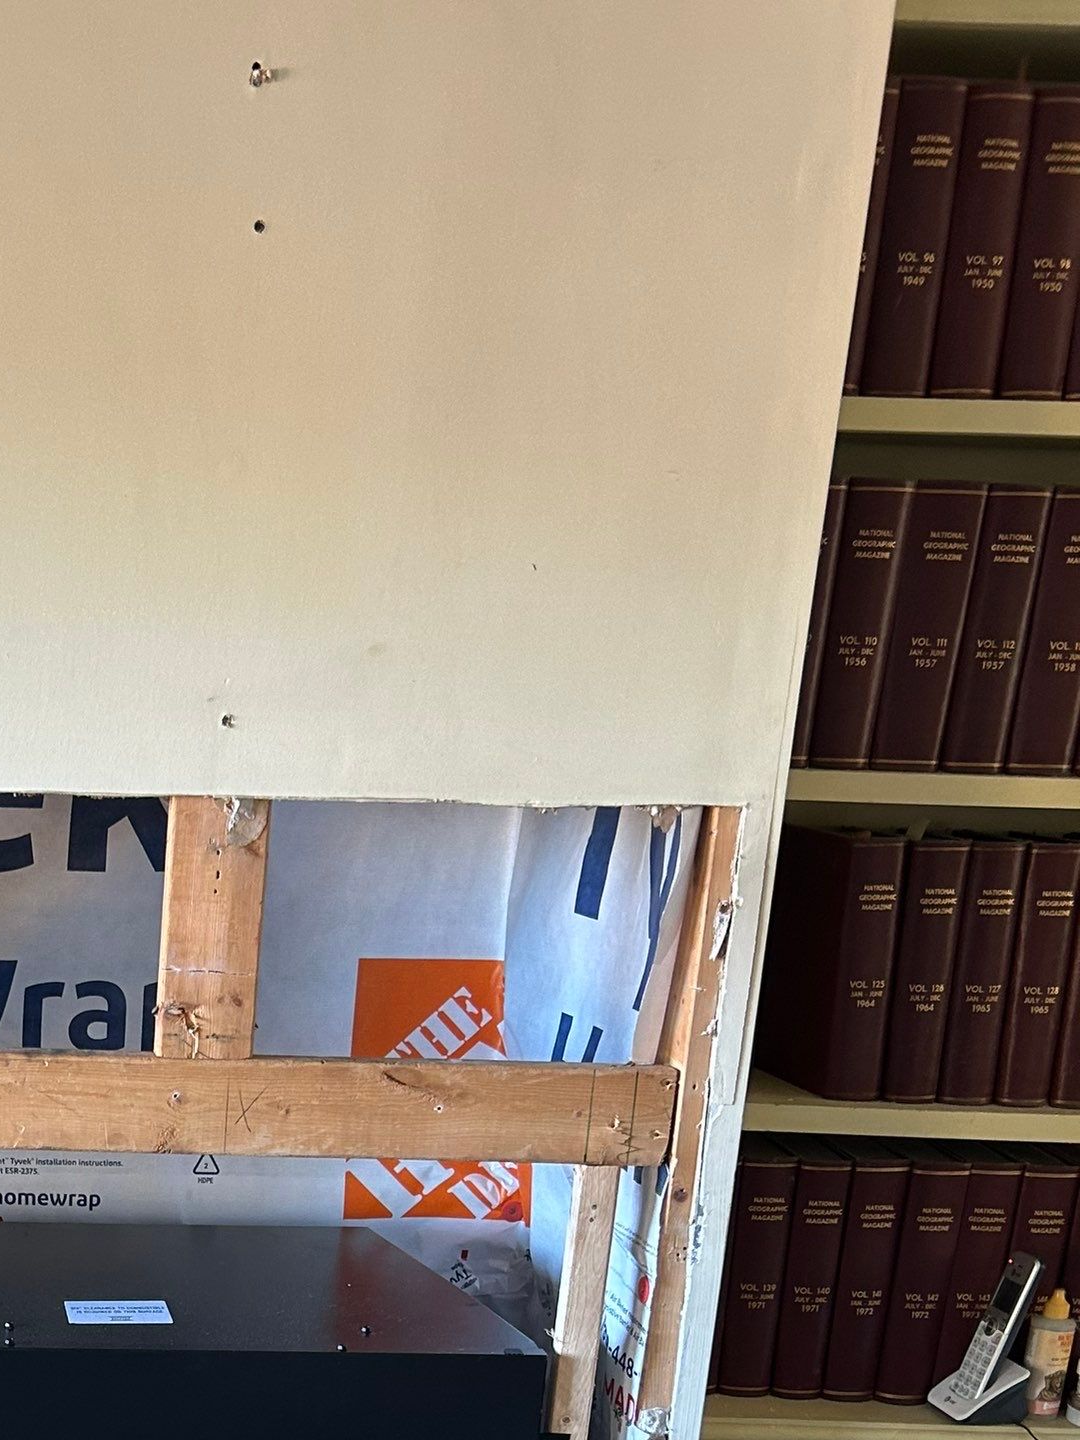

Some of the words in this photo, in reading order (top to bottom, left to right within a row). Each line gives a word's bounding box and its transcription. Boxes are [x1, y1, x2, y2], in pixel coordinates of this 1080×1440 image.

[992, 256, 1003, 266] 97
[972, 279, 994, 289] 1950
[859, 529, 894, 537] NATIONAL
[998, 534, 1033, 542] NATIONAL
[852, 540, 896, 548] GEOGRAPHIC
[991, 544, 1035, 552] GEOGRAPHIC
[855, 551, 890, 559] MAGAZINE
[864, 636, 877, 646] 110
[937, 638, 947, 647] 111
[1003, 640, 1015, 649] 112
[844, 658, 867, 666] 1956
[915, 659, 937, 668] 1957
[982, 661, 1004, 670] 1957
[872, 980, 885, 988] 125
[932, 984, 944, 992] 126
[857, 1000, 874, 1008] 1964
[916, 1004, 934, 1012] 1964
[1031, 1006, 1049, 1014] 1965
[36, 1158, 76, 1166] installation
[805, 1217, 838, 1225] MAGAZINE
[762, 1284, 776, 1292] 139
[817, 1287, 830, 1295] 140
